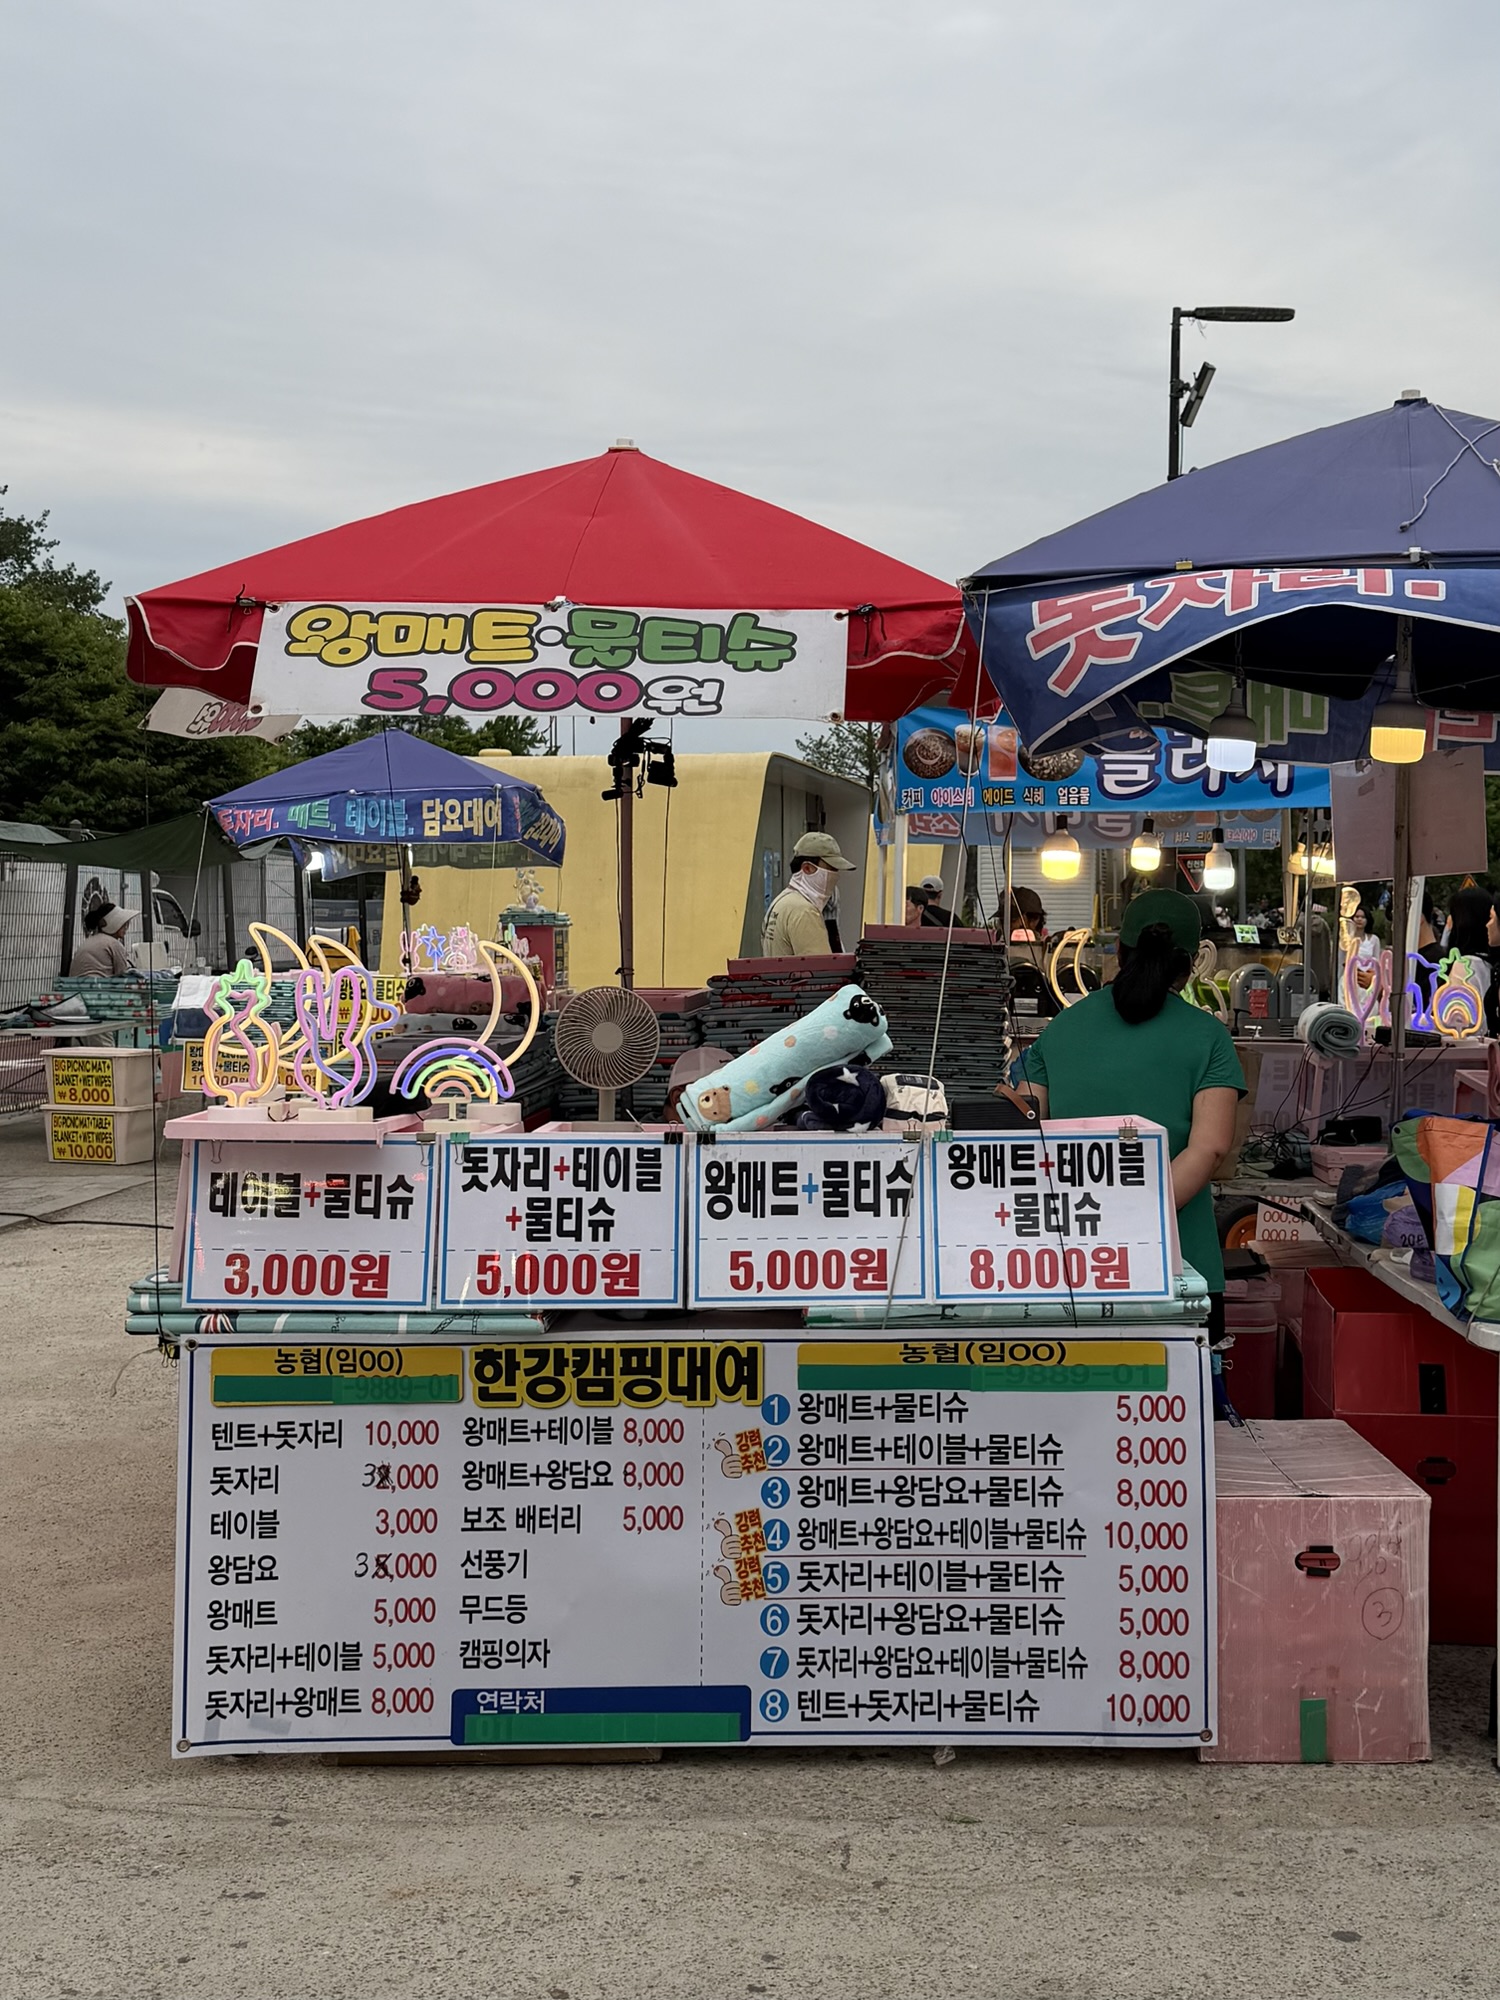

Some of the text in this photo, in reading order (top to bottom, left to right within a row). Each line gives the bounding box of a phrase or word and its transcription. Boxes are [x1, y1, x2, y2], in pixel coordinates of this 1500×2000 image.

[362, 667, 725, 716] 5,000원
[902, 787, 924, 808] 커피
[983, 788, 1015, 805] 에이드
[1057, 787, 1090, 805] 얼음물
[422, 798, 502, 836] 담요대여
[55, 1060, 66, 1072] BIG
[67, 1060, 91, 1072] PICNIC
[95, 1075, 111, 1087] WIPES
[95, 1132, 112, 1144] WIPES
[461, 1147, 662, 1193] 돗자리+테이블
[947, 1141, 1145, 1190] 왕매트+테이블
[209, 1172, 415, 1220] 테이블+물티슈
[704, 1159, 915, 1221] 왕매트+물티슈
[506, 1197, 615, 1242] +물티슈
[995, 1192, 1101, 1237] +물티슈
[224, 1253, 390, 1299] 3,000원
[476, 1253, 641, 1299] 5,000원
[729, 1248, 889, 1294] 5,000원
[969, 1246, 1130, 1292] 8,000원
[473, 1345, 763, 1405] 한강캠핑대여
[798, 1392, 968, 1424] 왕매트+물티슈
[1117, 1395, 1185, 1425] 5,000
[212, 1419, 439, 1450] 텐트+돗자리 10,000
[463, 1416, 684, 1447] 왕매트+테이블 8,000
[735, 1428, 762, 1452] 강력
[741, 1449, 767, 1474] 추천
[798, 1434, 1063, 1466] 왕매트+테이블+물티슈
[1117, 1436, 1186, 1467] 8,000
[210, 1465, 278, 1495] 돗자리
[462, 1460, 684, 1491] 왕매트+왕담요 8,000
[797, 1475, 1064, 1508] 왕매트+왕담요+물티슈
[1117, 1479, 1187, 1510] 8,000
[211, 1508, 437, 1540] 테이블 3,000
[461, 1505, 683, 1534] 보조 배터리 5,000
[735, 1508, 762, 1533] 강력
[797, 1518, 1086, 1551] 왕매트+왕담요+테이블+물티슈
[1105, 1522, 1188, 1553] 10,000
[741, 1529, 767, 1555] 추천
[208, 1554, 278, 1585] 왕담요
[461, 1549, 527, 1579] 선풍기
[734, 1555, 762, 1580] 강력
[797, 1560, 1064, 1593] 돗자리+테이블+물티슈
[1119, 1565, 1188, 1596] 5,000
[740, 1576, 766, 1601] 추천
[207, 1597, 436, 1630] 왕매트 5,000
[460, 1595, 527, 1624] 무드등
[797, 1603, 1065, 1636] 돗자리+왕담요+물티슈
[1120, 1608, 1189, 1639] 5,000
[206, 1642, 435, 1675] 돗자리+테이블 5,000
[460, 1639, 550, 1669] 캠핑의자
[797, 1646, 1088, 1679] 돗자리+왕담요+테이블+물티슈
[1120, 1650, 1189, 1682] 8,000
[205, 1687, 434, 1720] 돗자리+왕매트 8,000
[476, 1690, 545, 1714] 연락처
[798, 1689, 1040, 1722] 텐트+돗자리+물티슈
[1107, 1694, 1190, 1725] 10,000
